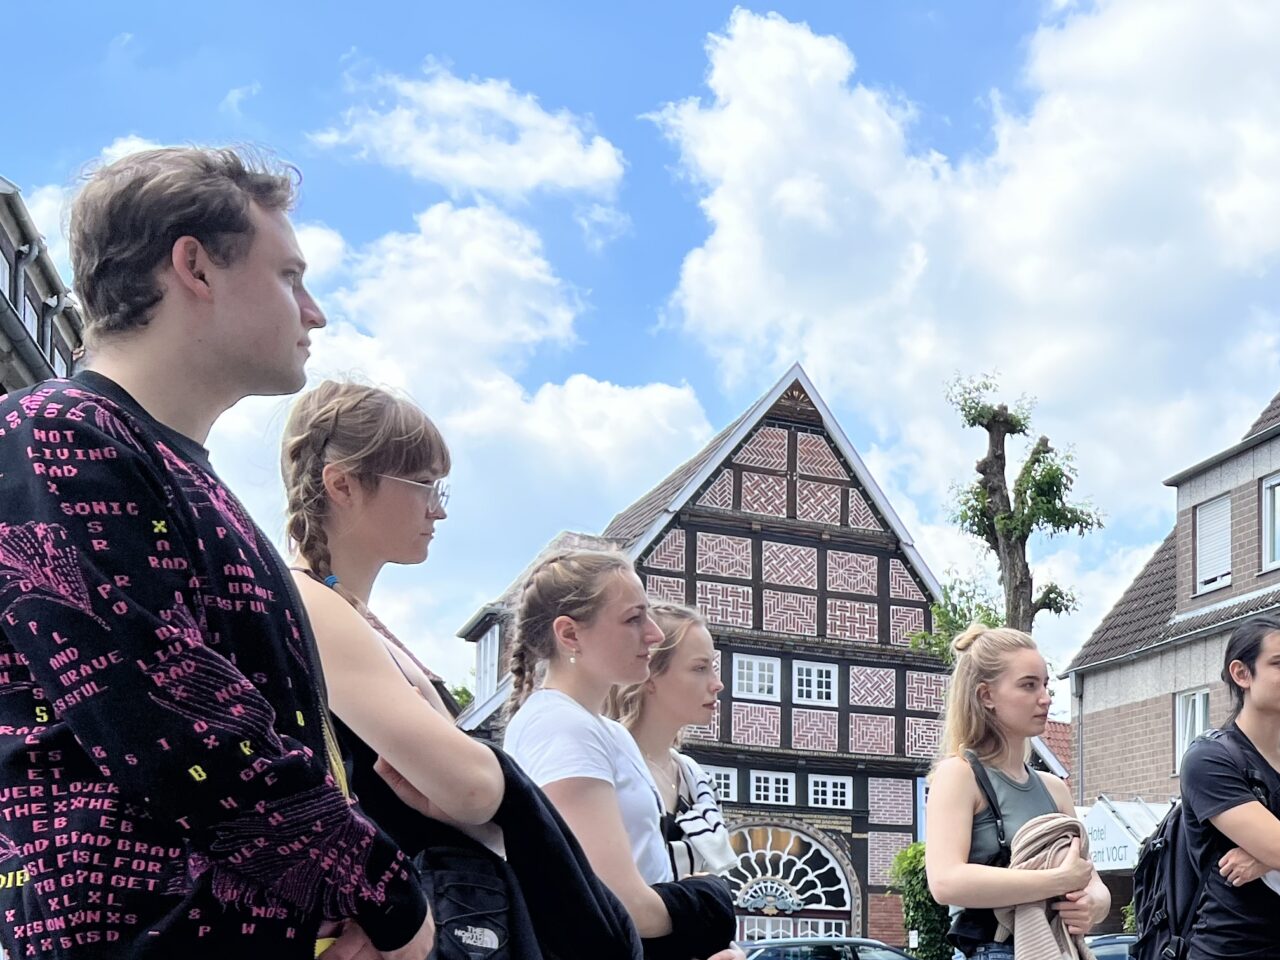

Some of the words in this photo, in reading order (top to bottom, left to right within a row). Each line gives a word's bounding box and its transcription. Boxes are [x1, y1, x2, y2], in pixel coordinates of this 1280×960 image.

[33, 462, 78, 478] RAD
[60, 501, 139, 516] SONIC
[1106, 845, 1128, 862] VOGT
